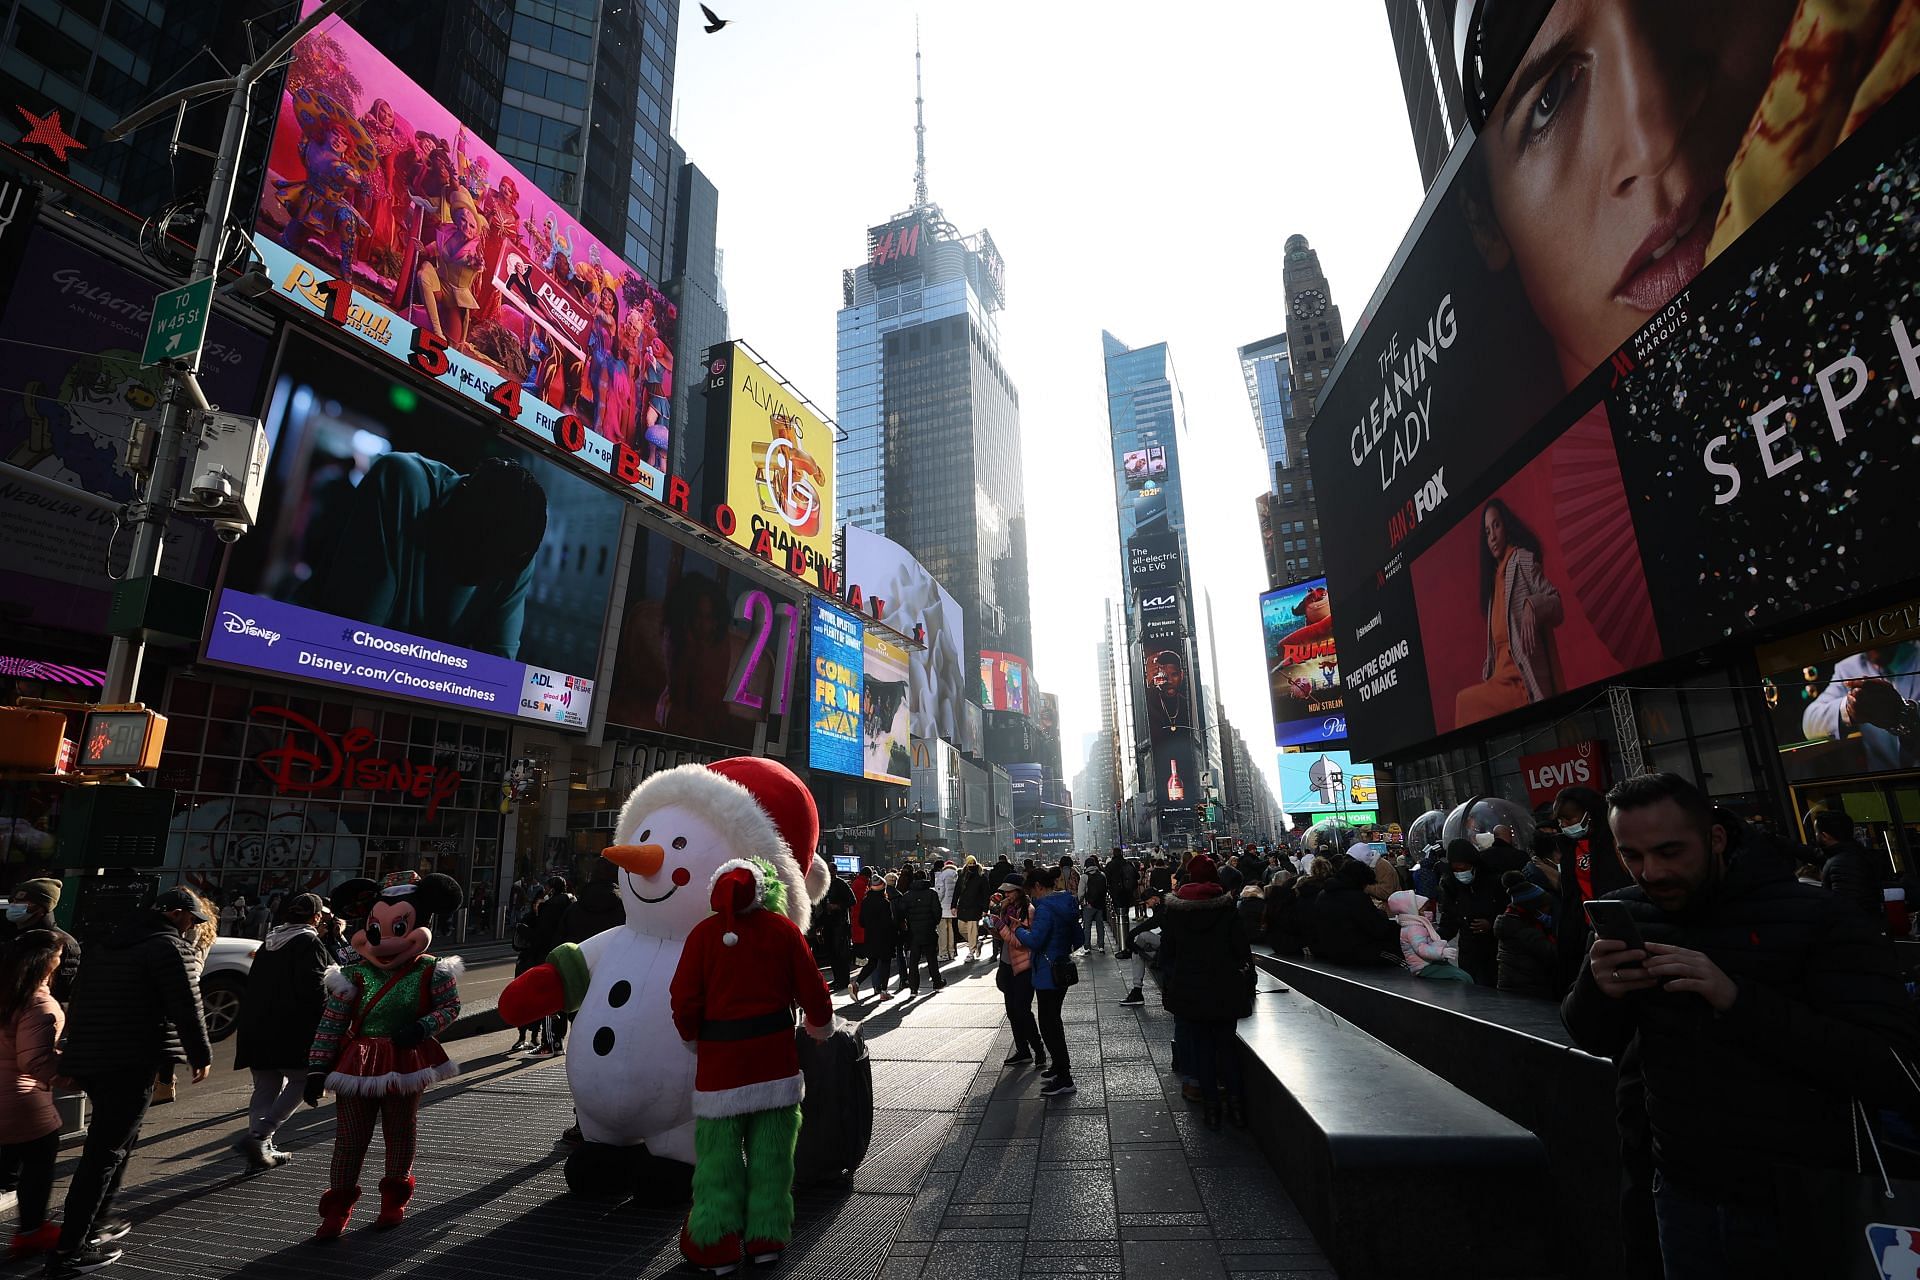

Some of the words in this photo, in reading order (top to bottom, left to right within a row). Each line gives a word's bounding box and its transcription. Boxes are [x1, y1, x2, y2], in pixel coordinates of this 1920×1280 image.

[872, 224, 920, 268] H&M
[157, 318, 168, 334] W
[168, 312, 184, 330] 45
[187, 308, 200, 323] St
[175, 292, 190, 310] TO
[537, 282, 588, 332] RuPaul
[1634, 291, 1692, 347] MARRIOTT
[1378, 332, 1400, 379] THE
[1638, 311, 1688, 361] MARQUIS
[710, 377, 724, 388] LG
[1351, 293, 1458, 466] CLEANING
[742, 376, 804, 439] ALWAYS
[1380, 385, 1432, 492] LADY
[1408, 500, 1416, 530] 3
[1414, 466, 1448, 523] FOX
[1131, 548, 1148, 556] The
[1132, 552, 1178, 564] all-electric
[1132, 566, 1146, 574] Kia
[1149, 562, 1166, 572] EV6
[222, 610, 280, 647] Disney
[342, 627, 468, 669] #ChooseKindness
[298, 650, 496, 703] Disney.com/ChooseKindness
[531, 672, 552, 688] ADL
[815, 656, 858, 688] COME
[1346, 659, 1378, 690] THEY'RE
[1379, 640, 1409, 670] GOING
[1359, 684, 1371, 702] TO
[1372, 668, 1398, 697] MAKE
[815, 678, 859, 715] FROM
[815, 712, 859, 738] AWAY
[251, 704, 462, 824] Disney
